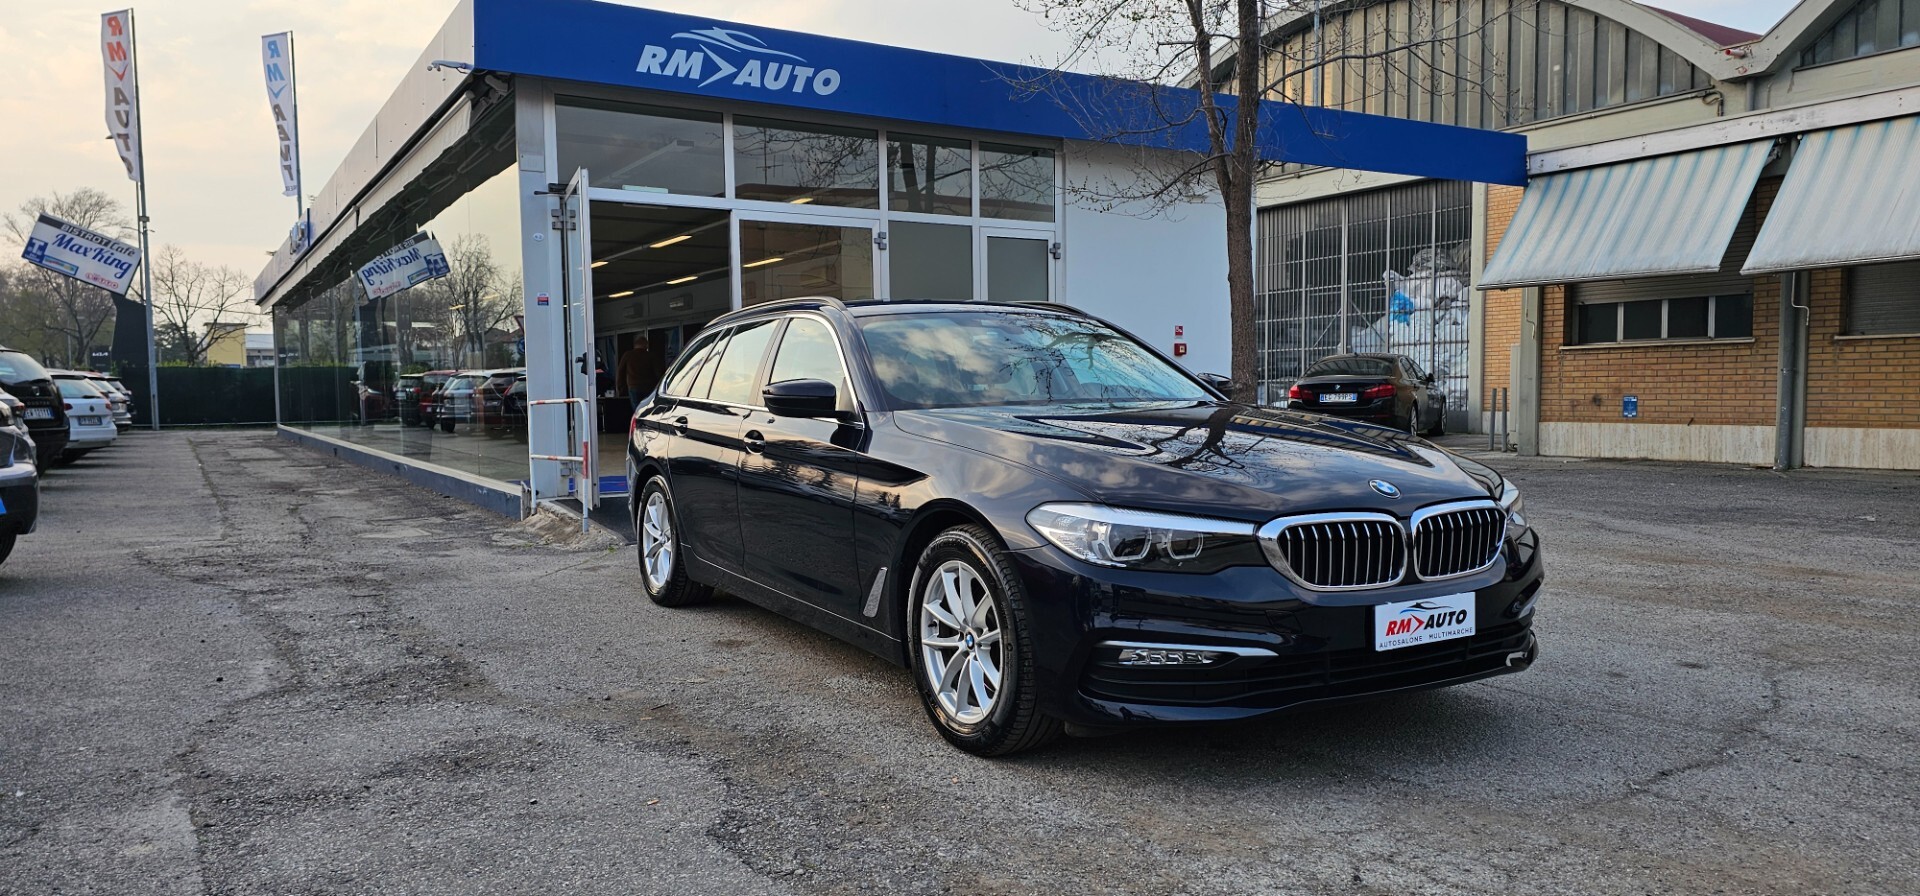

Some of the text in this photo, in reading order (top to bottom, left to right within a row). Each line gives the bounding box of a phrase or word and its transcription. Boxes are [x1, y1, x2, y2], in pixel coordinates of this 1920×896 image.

[636, 44, 841, 96] RM AUTO
[60, 223, 136, 257] BISTROT Café
[1379, 627, 1473, 648] AUTOSALONE MULTIMARCHE
[1385, 609, 1468, 637] RM AUTO
